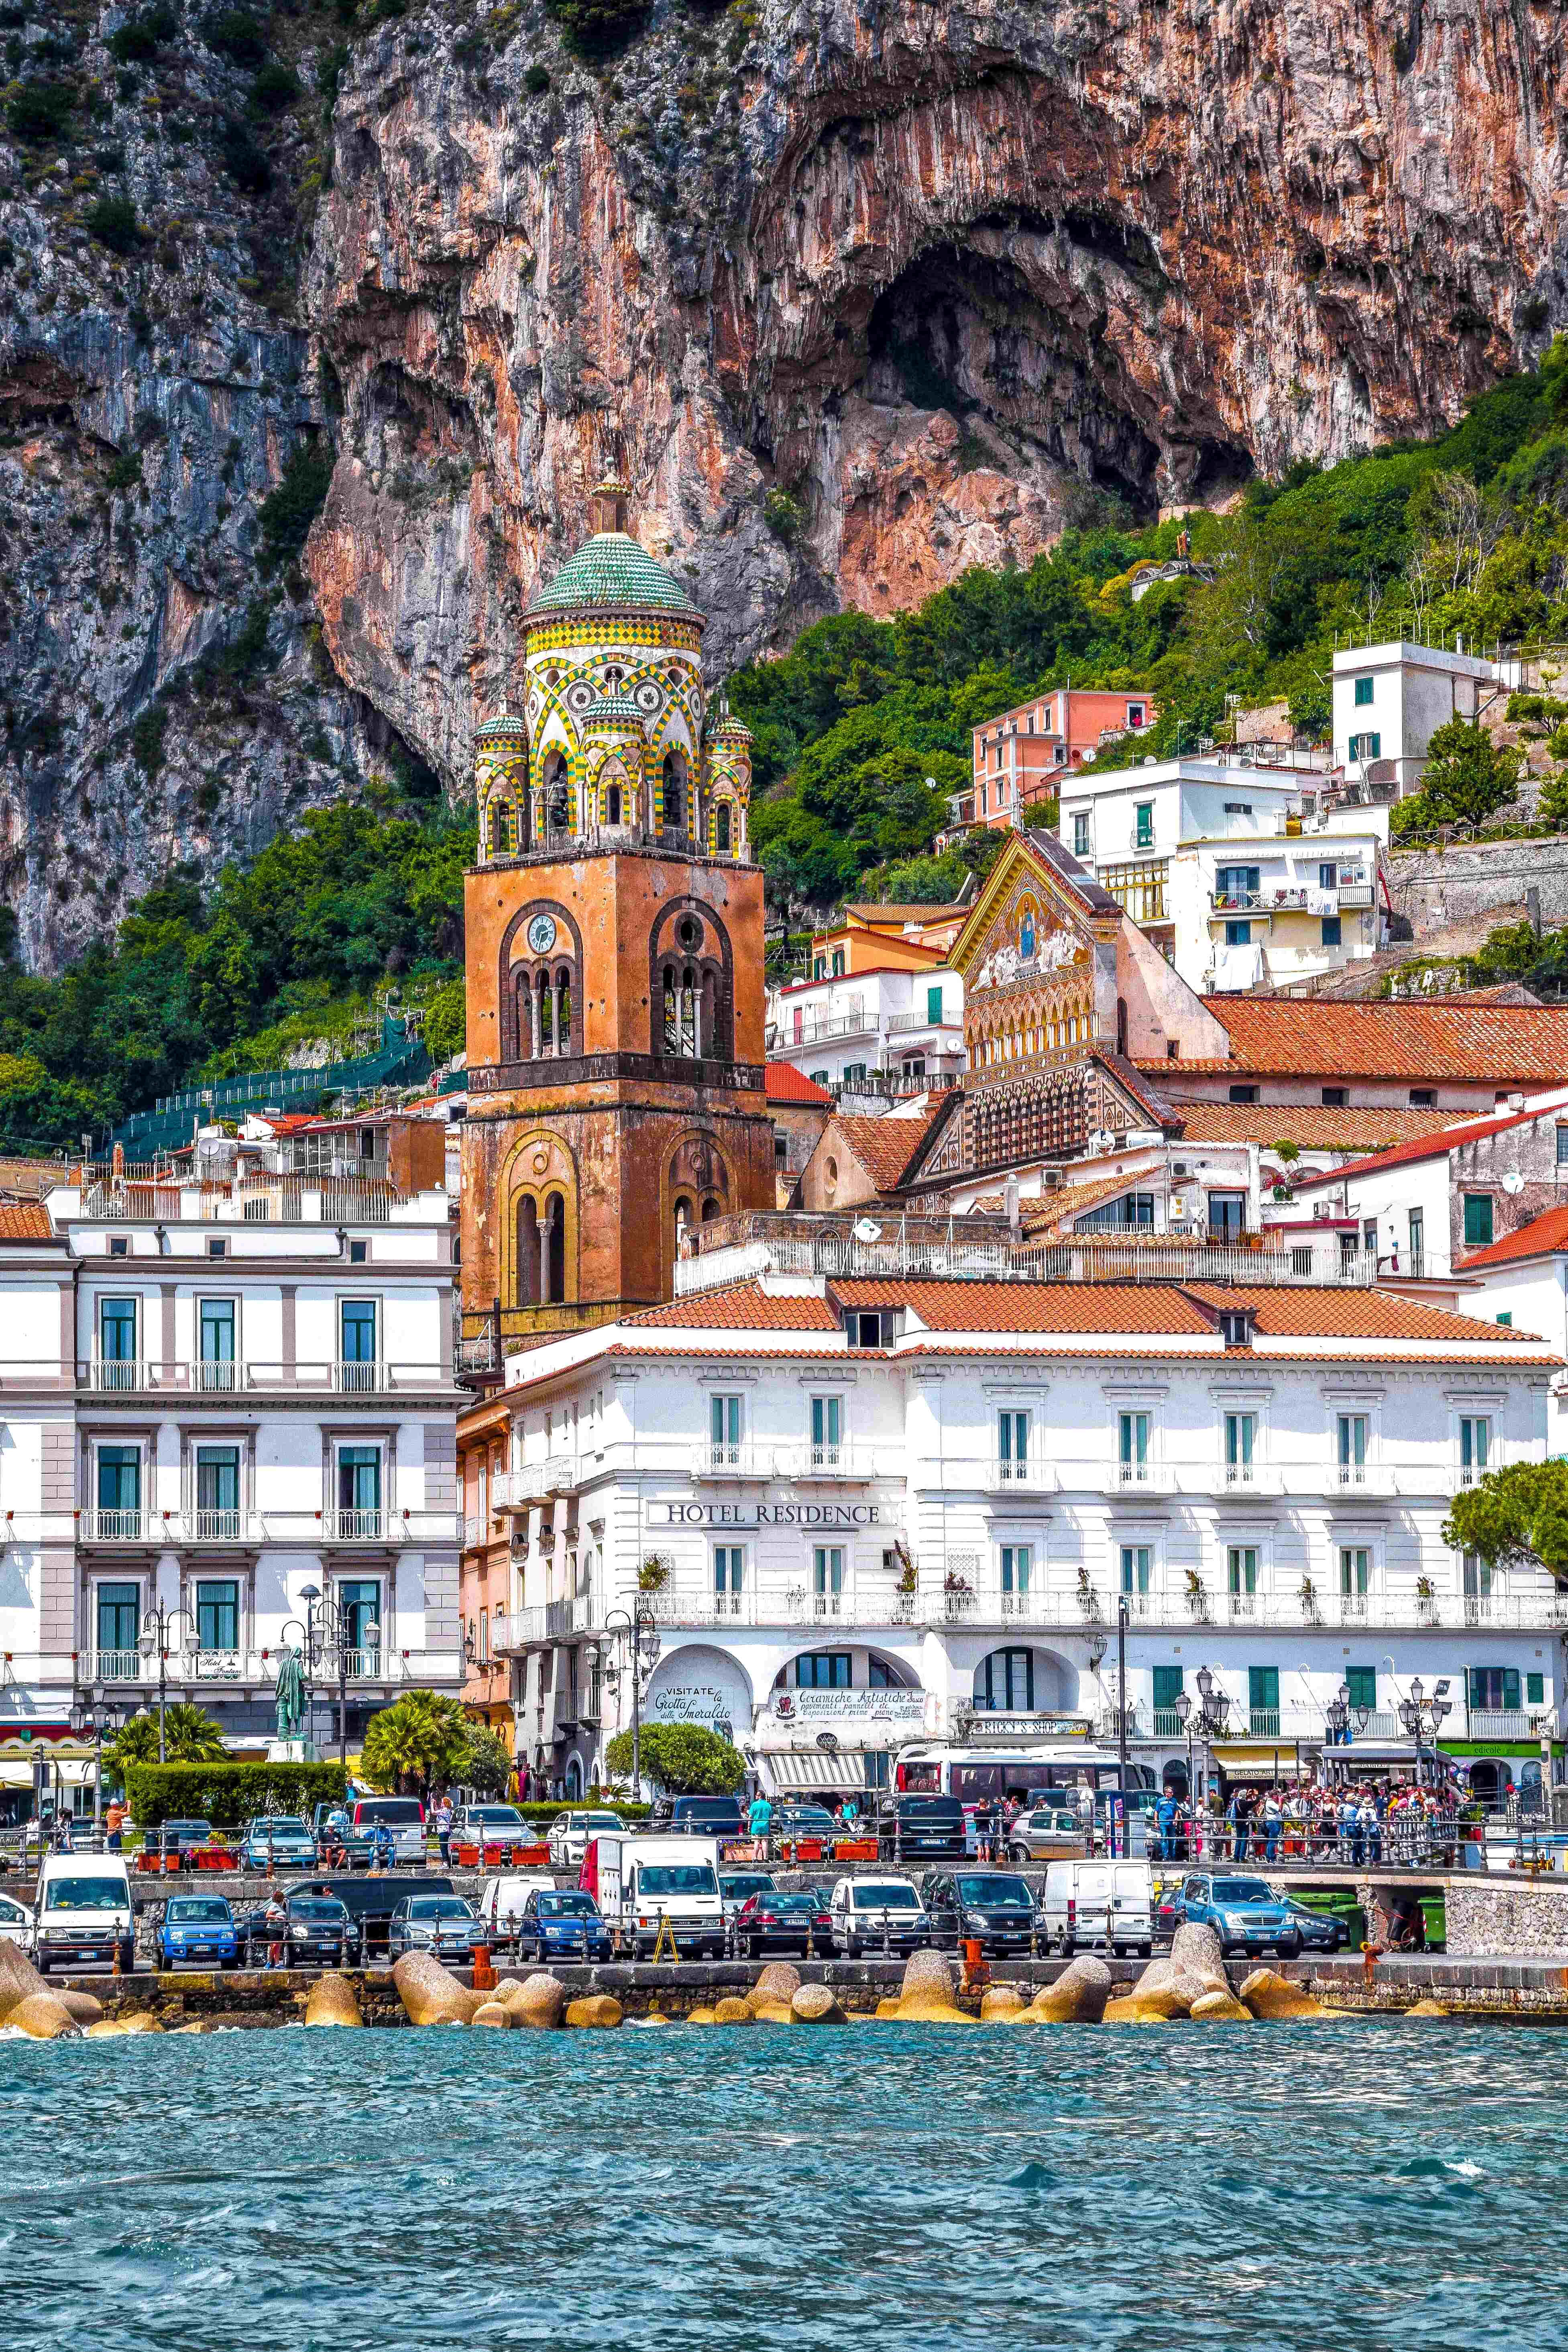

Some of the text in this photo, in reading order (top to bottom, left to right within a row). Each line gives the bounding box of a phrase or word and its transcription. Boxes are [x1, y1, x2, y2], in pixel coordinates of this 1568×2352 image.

[667, 1505, 880, 1524] HOTEL RESIDENCE
[200, 1658, 222, 1666] Hotel
[714, 1690, 723, 1702] la
[800, 1690, 923, 1703] Ceramiche Artistiche Fusco
[655, 1693, 686, 1712] Grotta
[800, 1702, 837, 1711] pavimenti
[678, 1700, 730, 1719] Smeraldo
[985, 1721, 1057, 1733] RICKY'S SHOP
